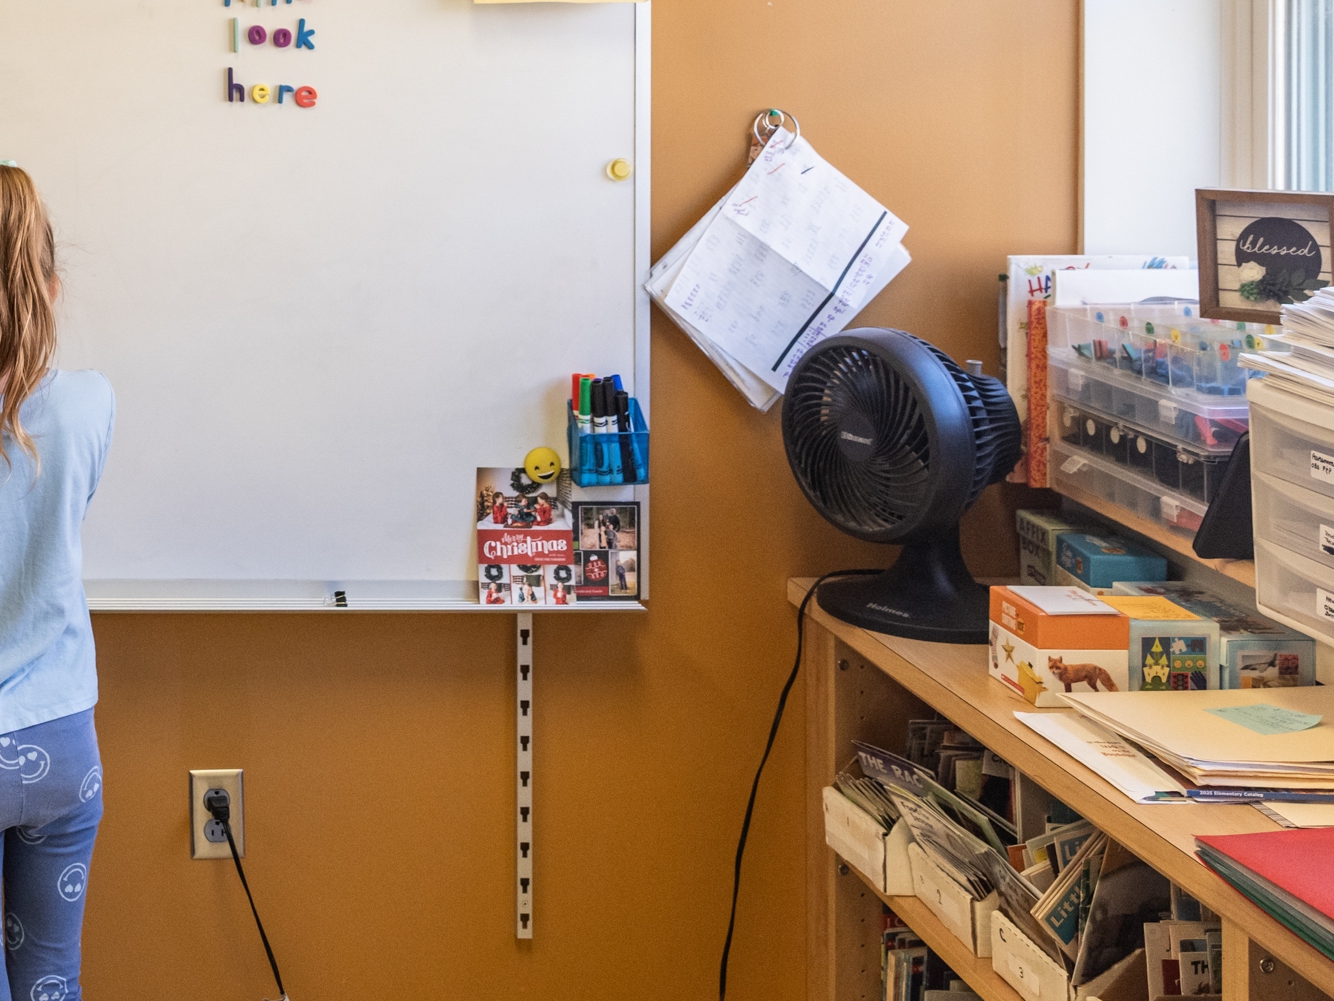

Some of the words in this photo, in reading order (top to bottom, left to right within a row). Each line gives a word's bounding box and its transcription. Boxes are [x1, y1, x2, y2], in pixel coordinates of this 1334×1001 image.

[233, 17, 315, 53] look
[228, 67, 318, 108] here
[1239, 234, 1316, 257] blessed
[483, 536, 567, 559] Christmas
[859, 751, 888, 773] THE
